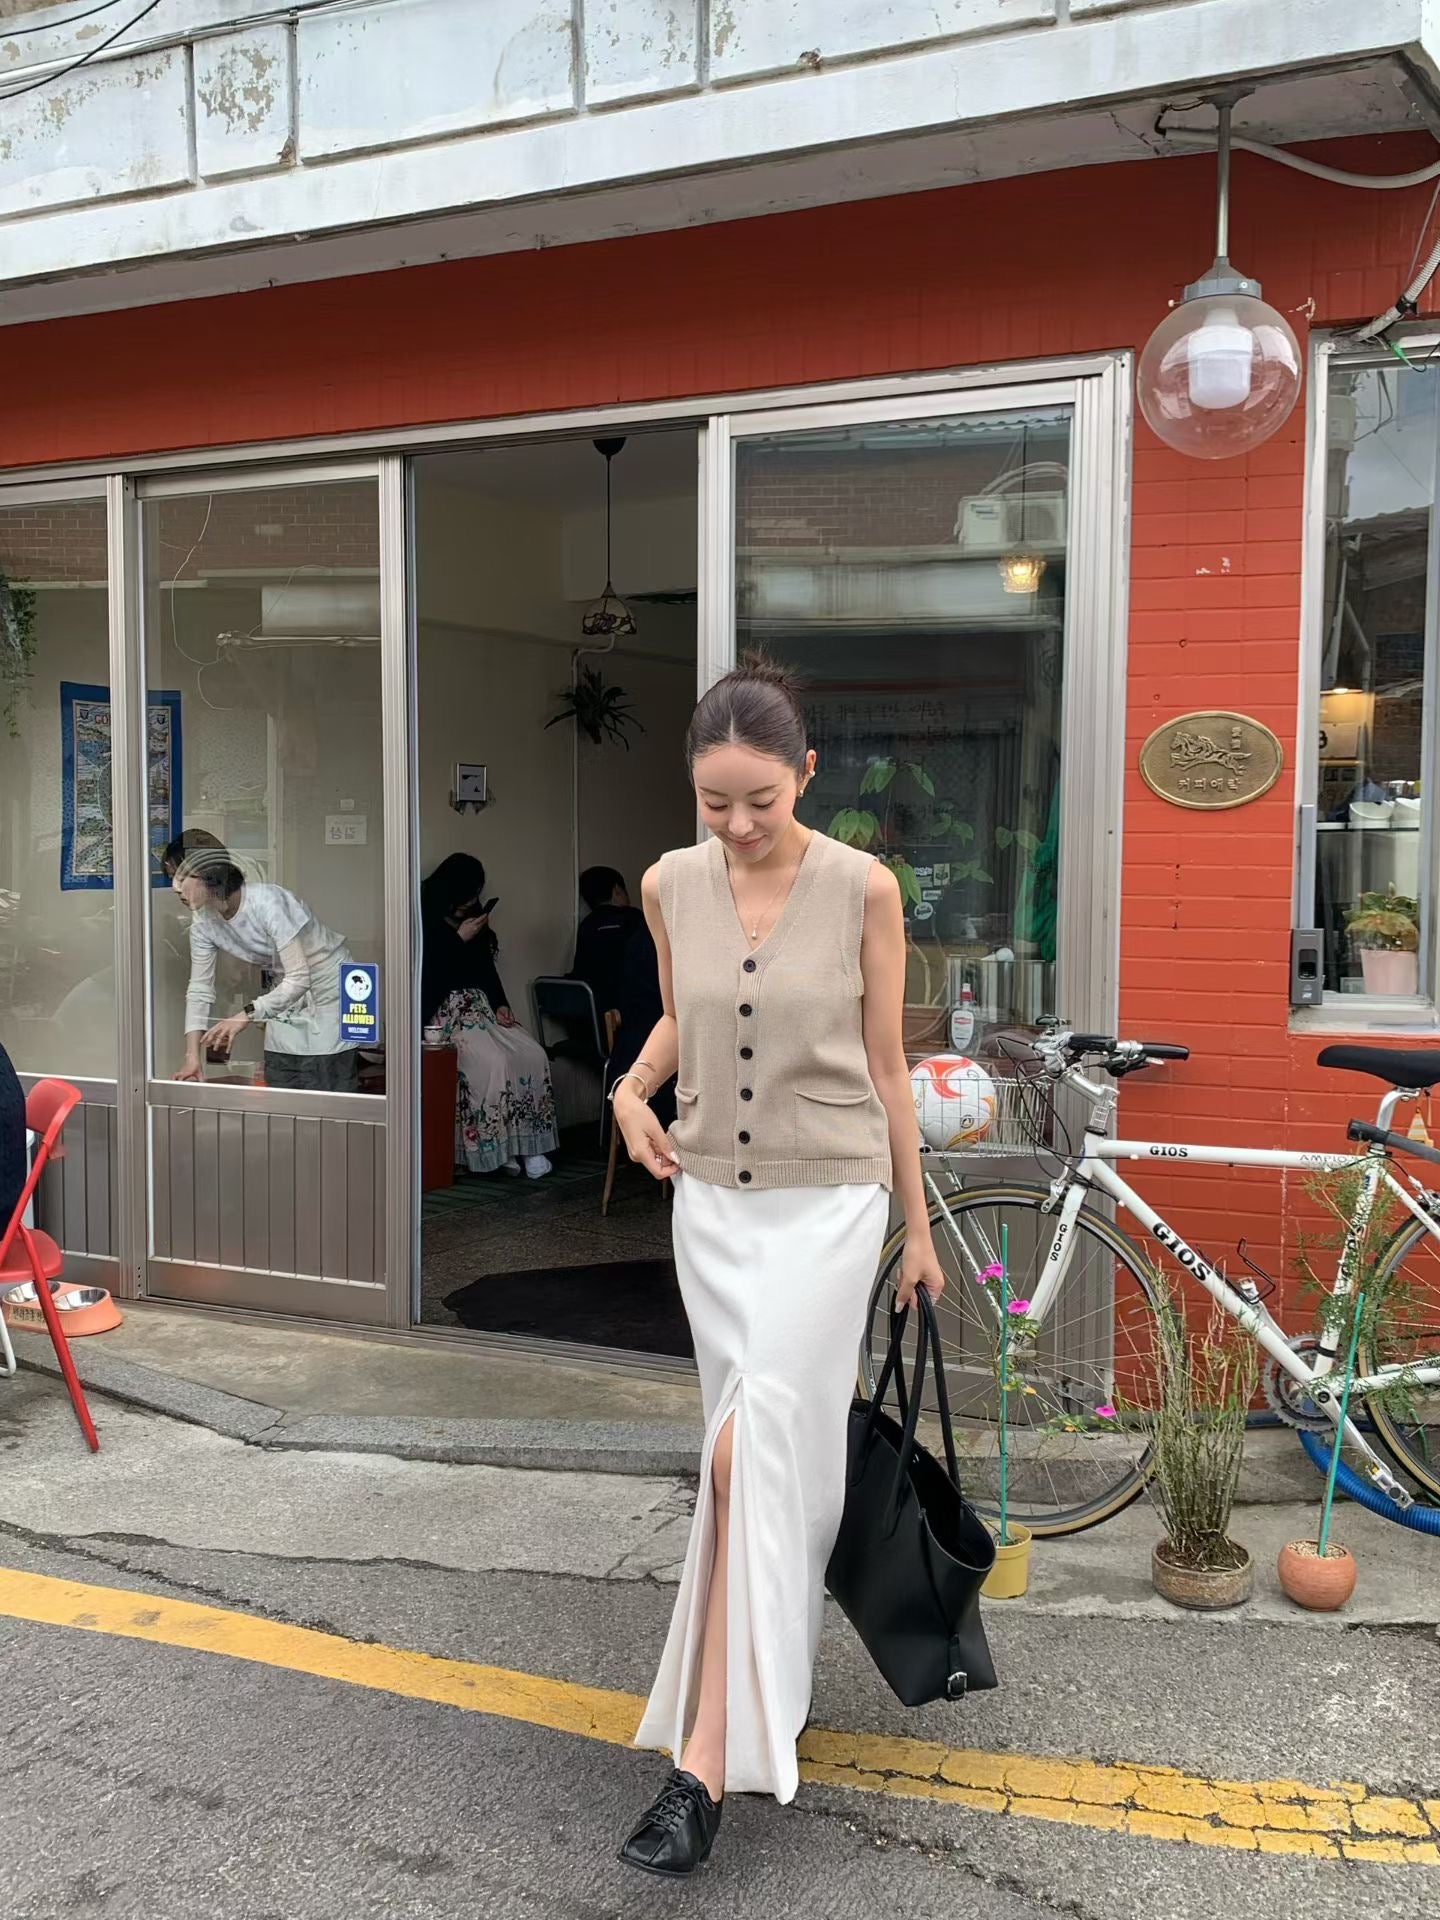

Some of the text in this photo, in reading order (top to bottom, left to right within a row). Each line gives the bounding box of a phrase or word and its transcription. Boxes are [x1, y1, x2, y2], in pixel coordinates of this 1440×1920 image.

[349, 1003, 367, 1014] PETS
[342, 1013, 375, 1025] ALLOWED
[1150, 1145, 1188, 1158] GIOS
[1050, 1223, 1068, 1262] GIOS
[1152, 1221, 1212, 1282] GIOS
